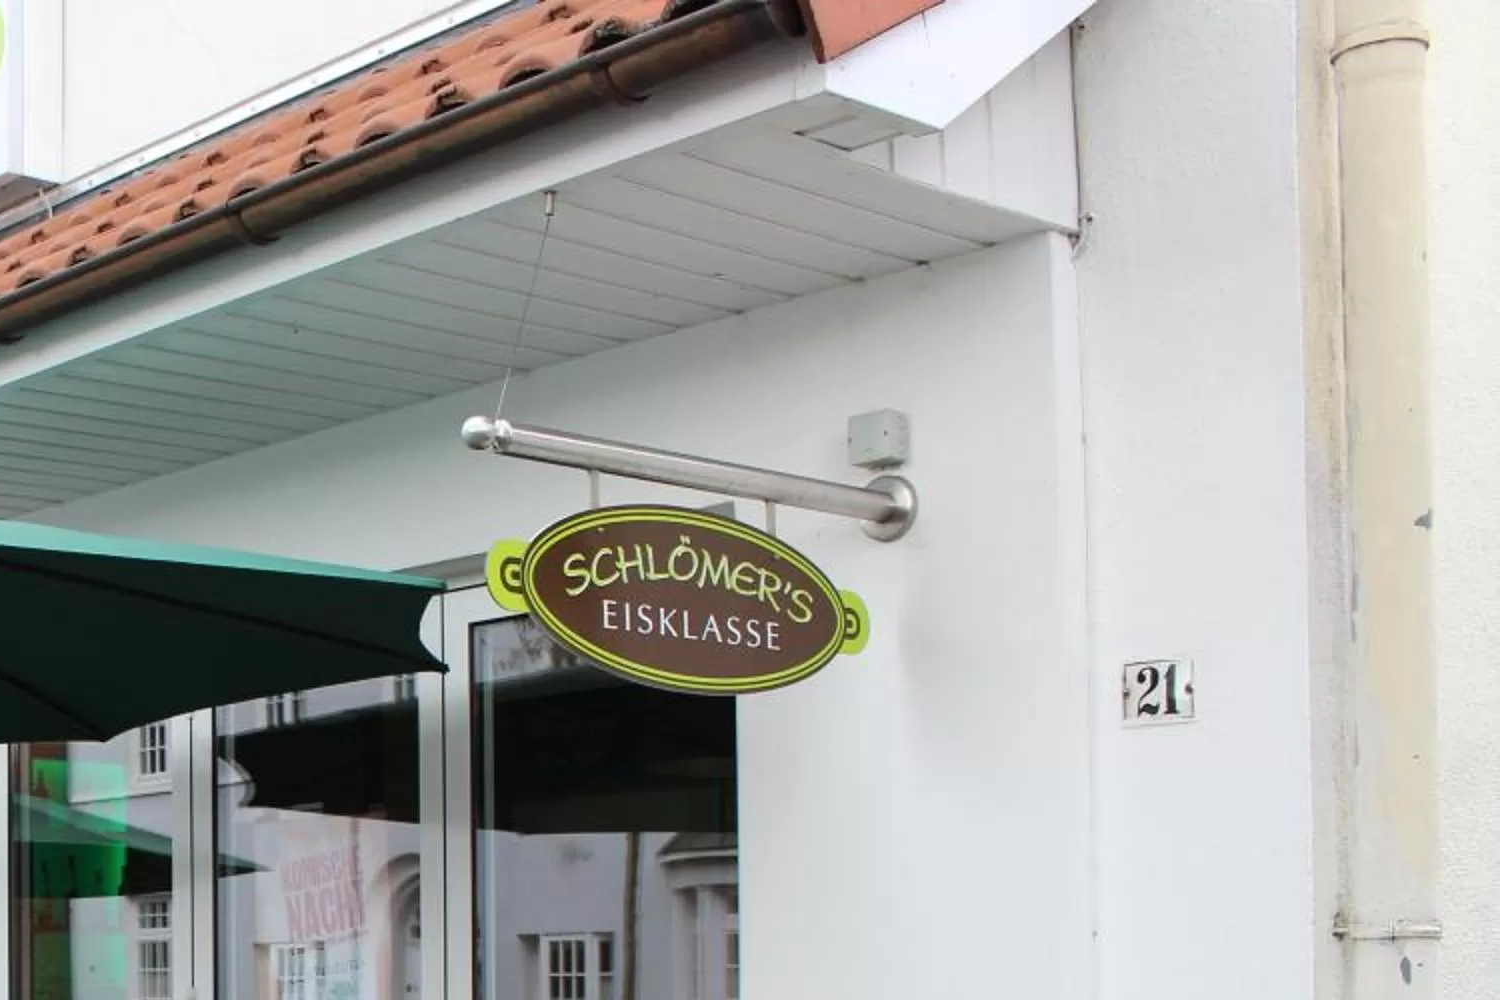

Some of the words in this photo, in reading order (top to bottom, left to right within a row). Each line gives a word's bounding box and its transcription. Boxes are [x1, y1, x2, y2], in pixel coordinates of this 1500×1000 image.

[562, 535, 814, 623] SCHLÖMER'S
[602, 599, 782, 652] EISKLASSE
[1136, 663, 1181, 717] 21
